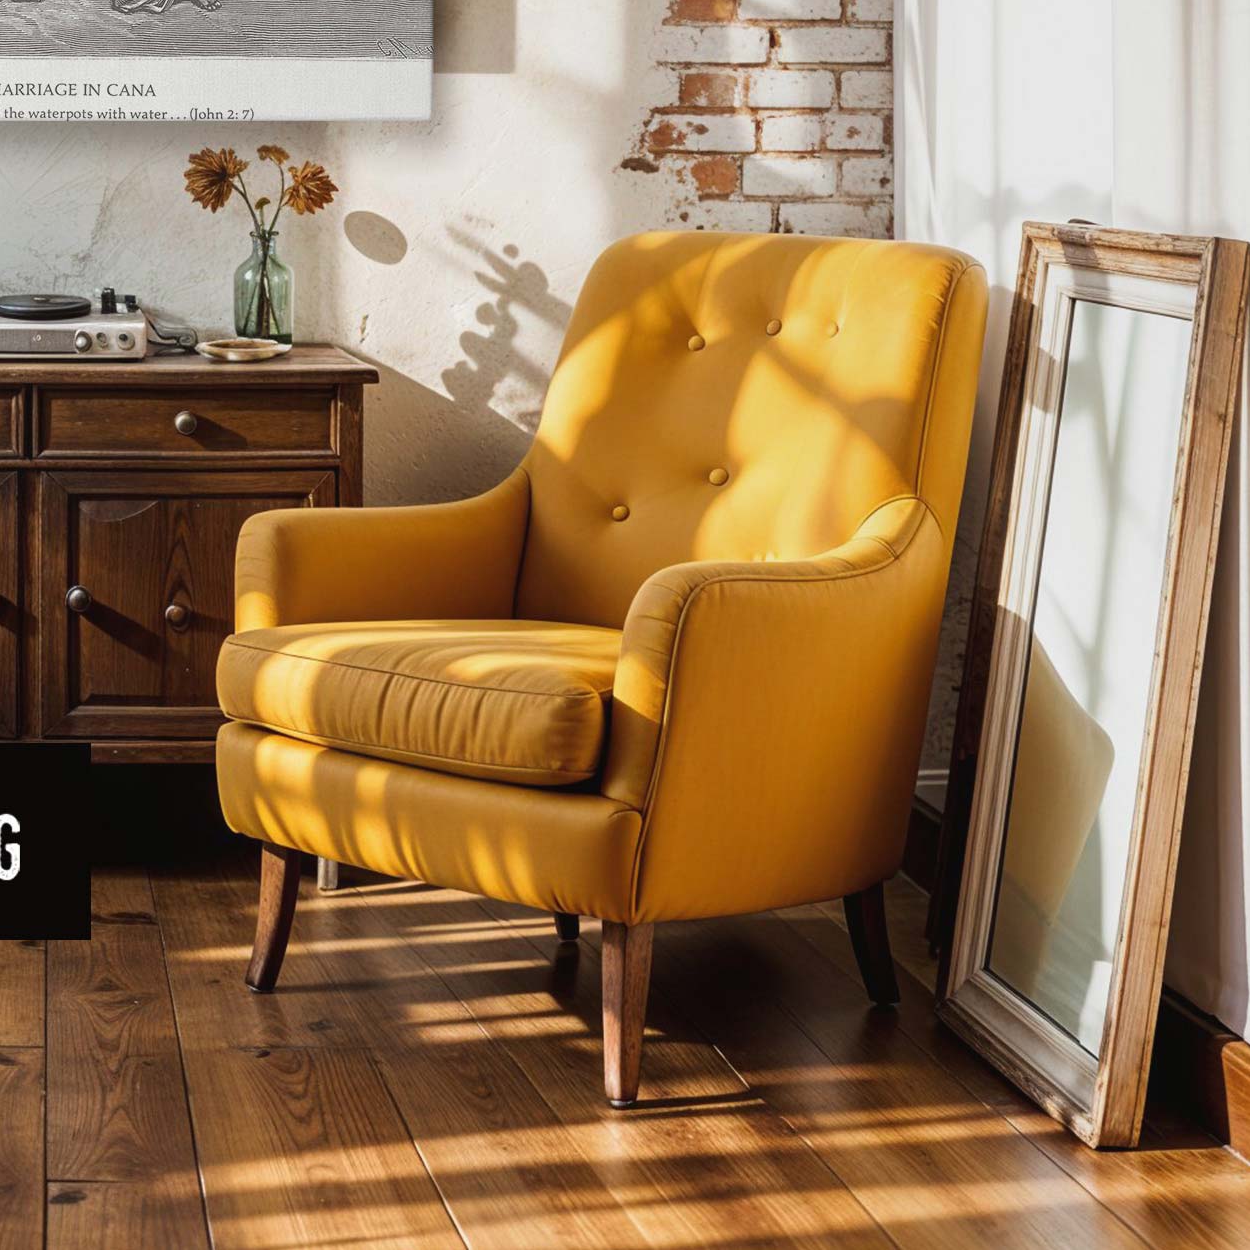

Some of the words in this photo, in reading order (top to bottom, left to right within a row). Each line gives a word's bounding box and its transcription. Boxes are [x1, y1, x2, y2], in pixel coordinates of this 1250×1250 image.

[83, 83, 101, 96] IN
[106, 83, 157, 97] CANA
[4, 106, 25, 119] the
[28, 107, 94, 121] waterpots
[96, 106, 127, 120] with
[189, 107, 224, 120] (John
